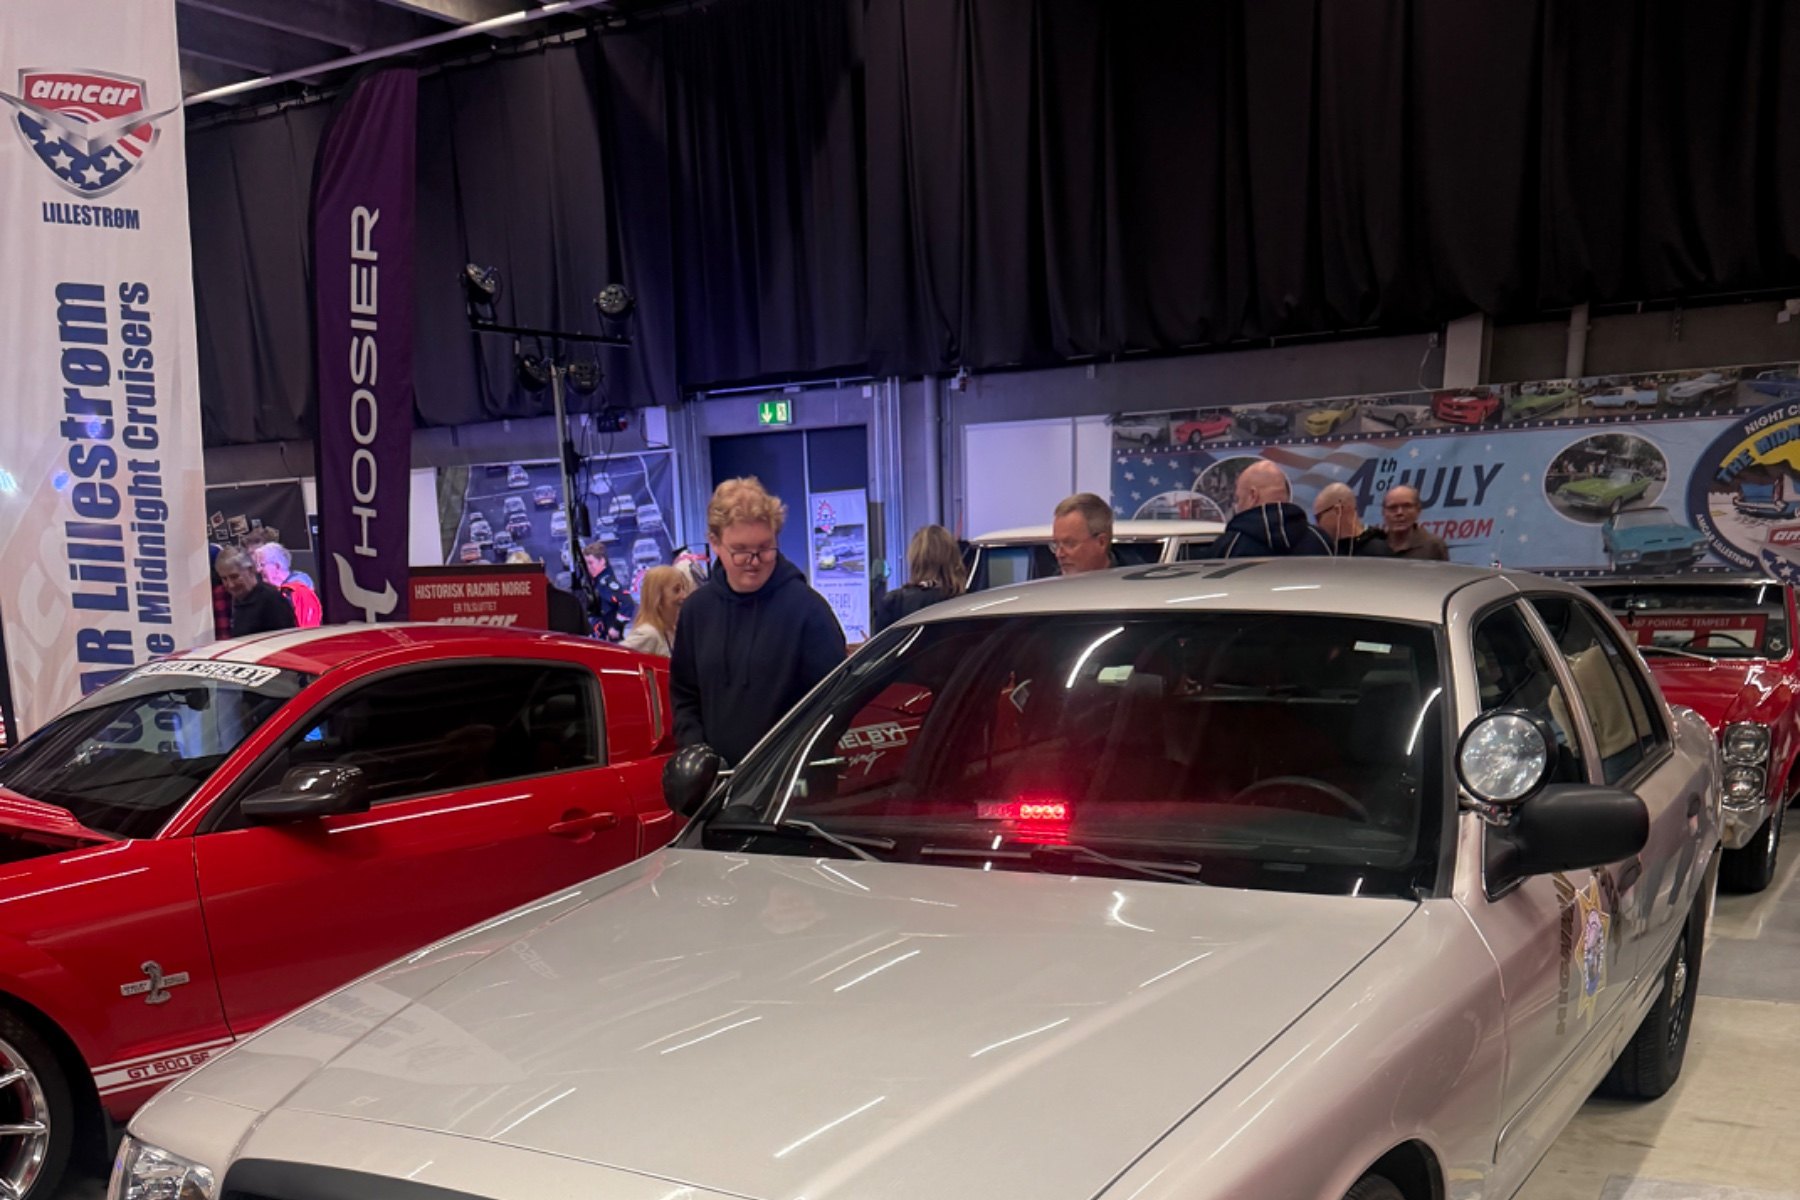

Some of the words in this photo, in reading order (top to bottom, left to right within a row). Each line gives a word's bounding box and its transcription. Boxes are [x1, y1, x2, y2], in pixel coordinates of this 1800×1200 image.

[30, 78, 137, 107] amcar
[42, 202, 140, 230] LILLESTRØM
[118, 281, 159, 450] Cruisers
[349, 205, 380, 557] HOOSIER
[1744, 408, 1785, 435] NIGHT
[55, 282, 130, 612] Lillestrøm
[1715, 448, 1755, 484] THE
[127, 458, 173, 625] Midnight
[414, 582, 464, 600] HISTORISK
[466, 581, 500, 598] RACING
[502, 581, 532, 596] NORGE
[1648, 617, 1688, 627] PONTIAC
[1693, 617, 1730, 627] TEMPEST
[127, 1065, 150, 1079] GT
